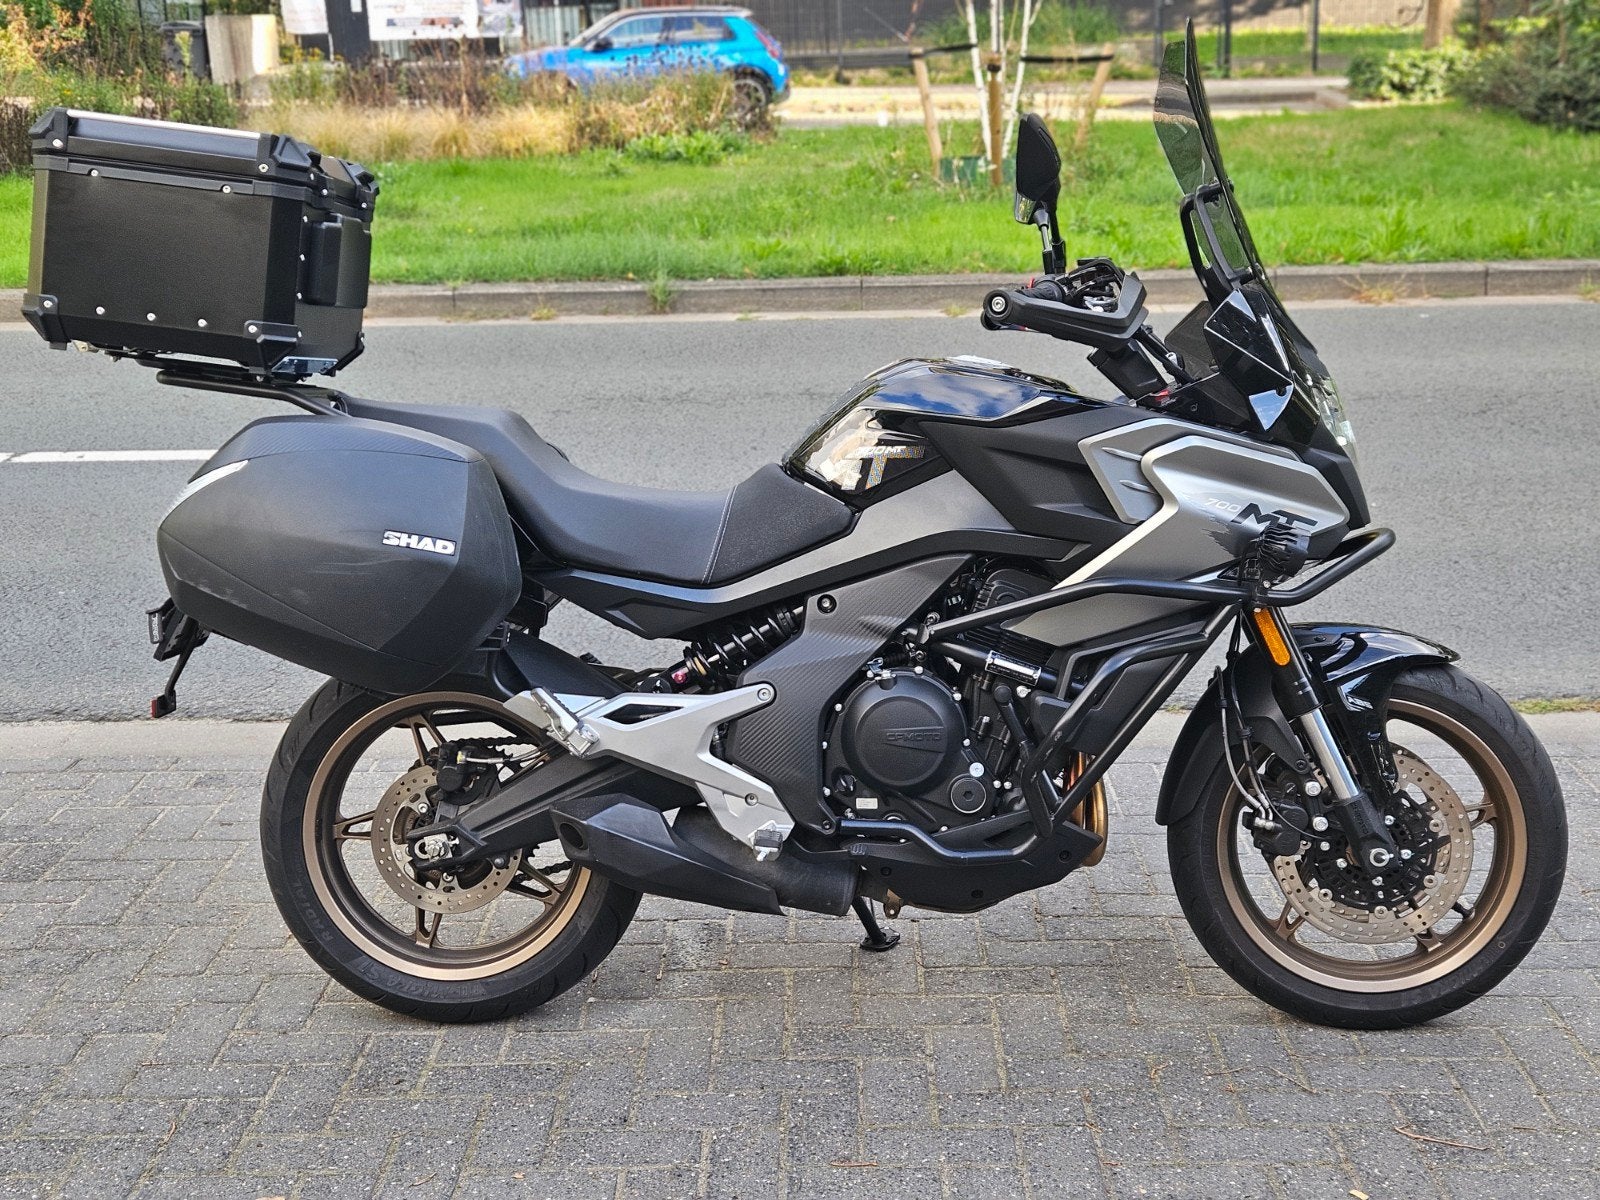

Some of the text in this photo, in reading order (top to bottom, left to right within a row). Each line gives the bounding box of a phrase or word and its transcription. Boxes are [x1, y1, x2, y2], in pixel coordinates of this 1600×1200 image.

[1205, 498, 1319, 533] 700 MT
[382, 530, 456, 555] SHAD
[886, 732, 941, 741] CFMOTO
